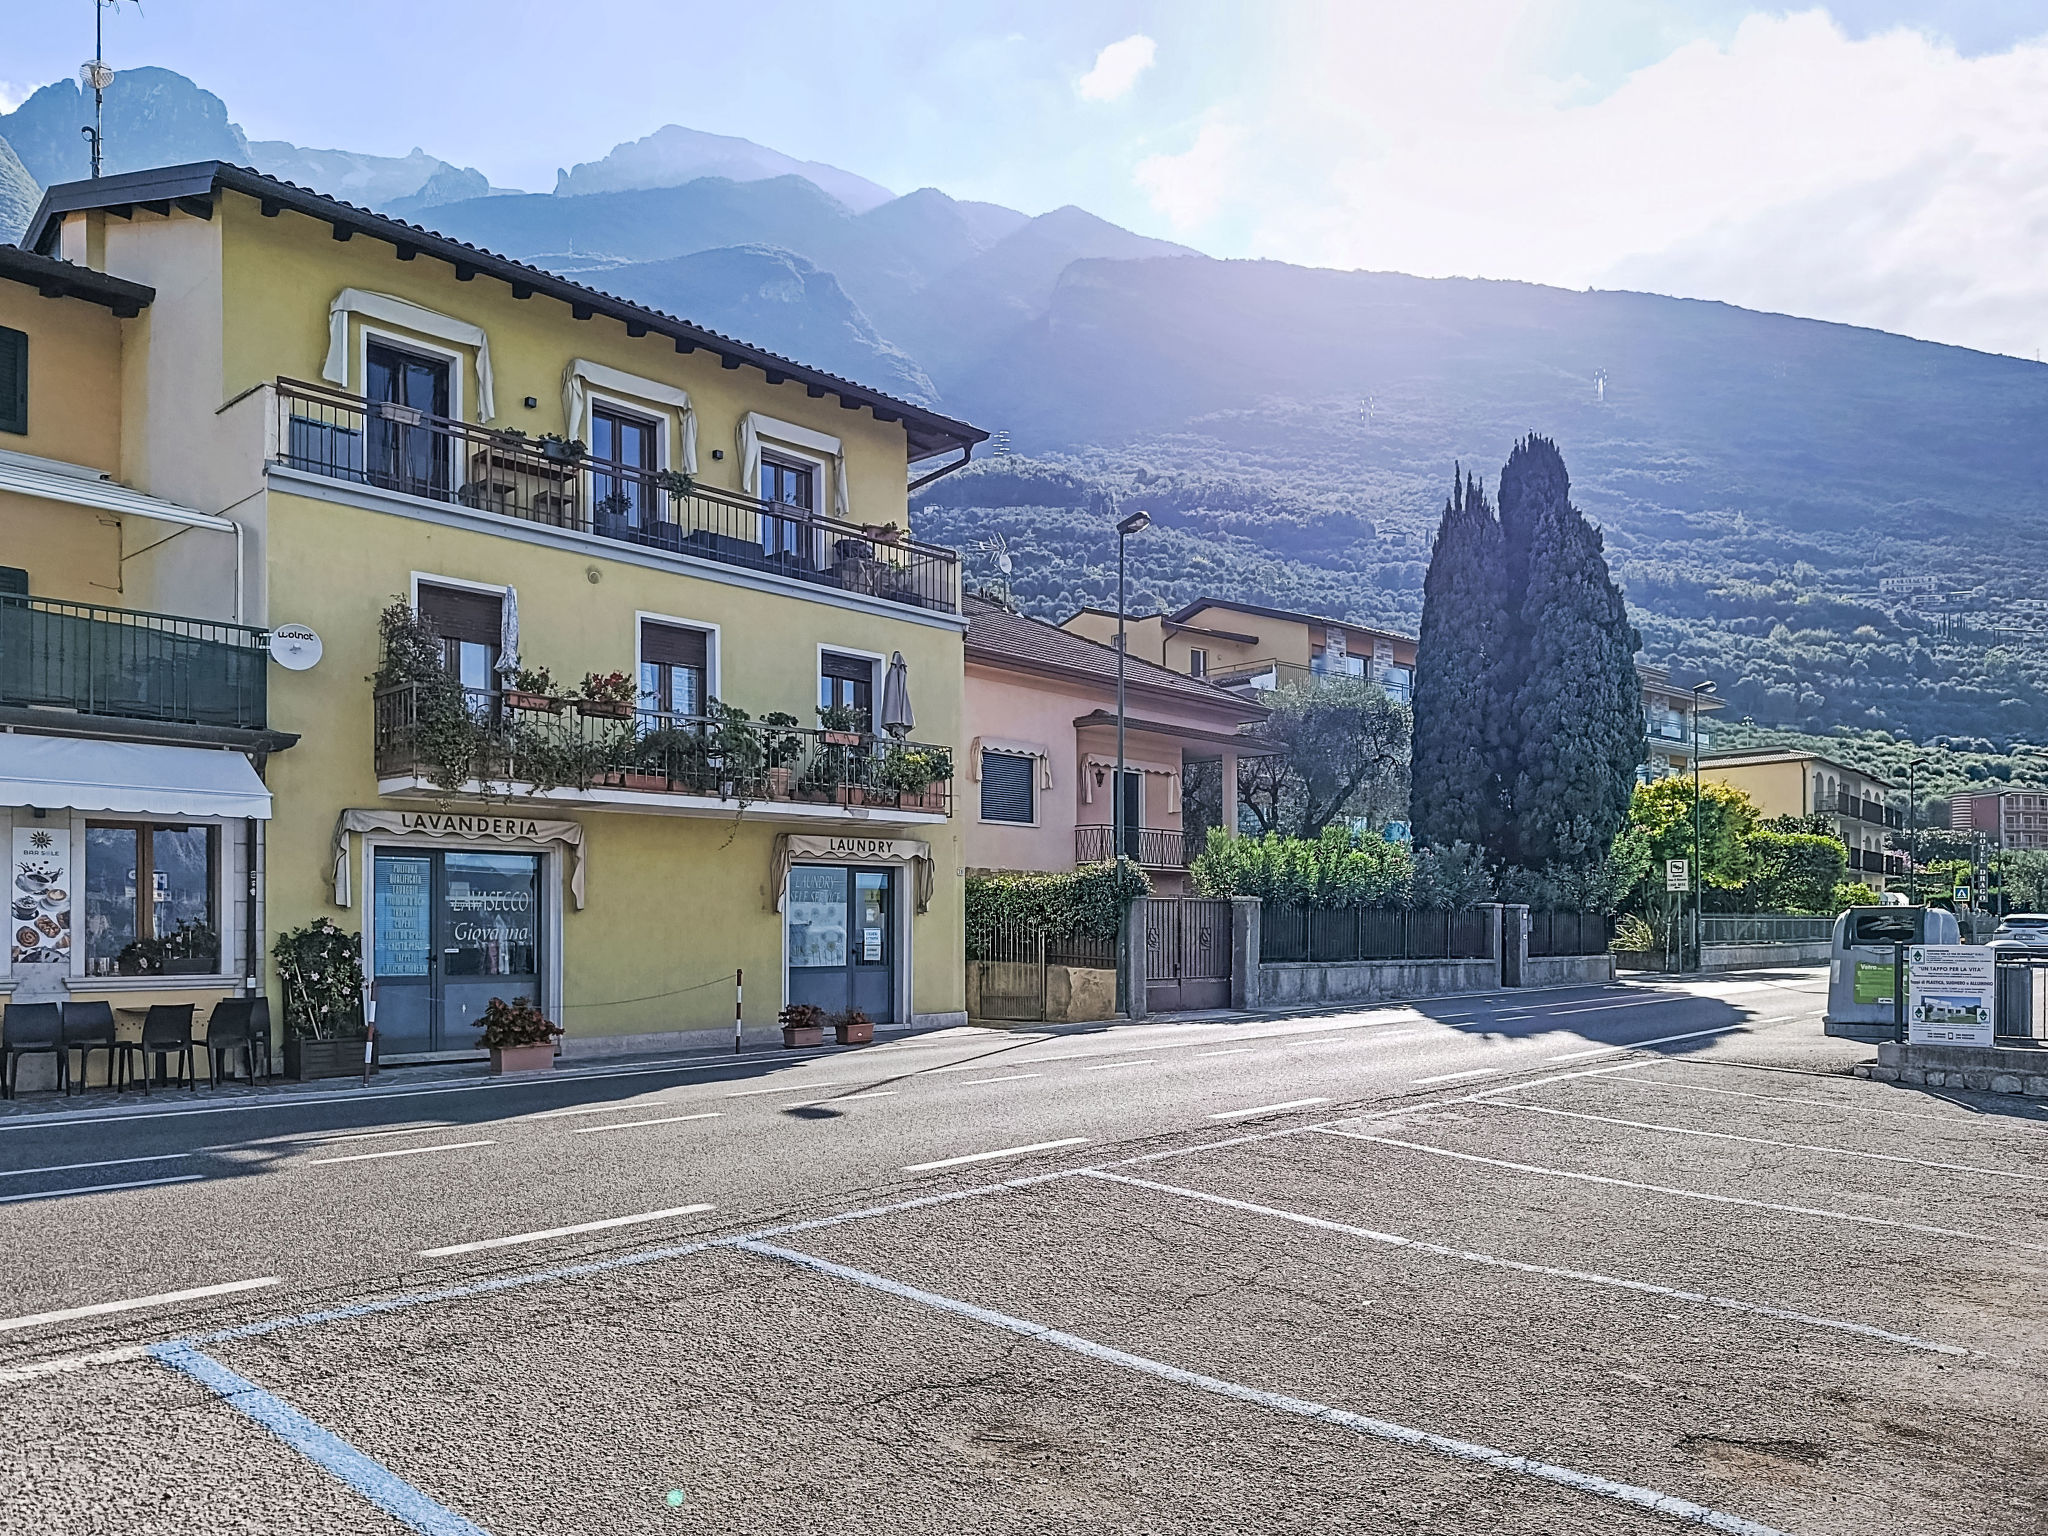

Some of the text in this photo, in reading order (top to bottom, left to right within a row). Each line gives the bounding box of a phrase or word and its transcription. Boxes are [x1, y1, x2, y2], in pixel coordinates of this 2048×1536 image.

[401, 814, 539, 835] LAVANDERIA
[830, 838, 893, 852] LAUNDRY
[795, 875, 833, 889] LAUNDRY
[453, 890, 529, 911] LAVASECCO
